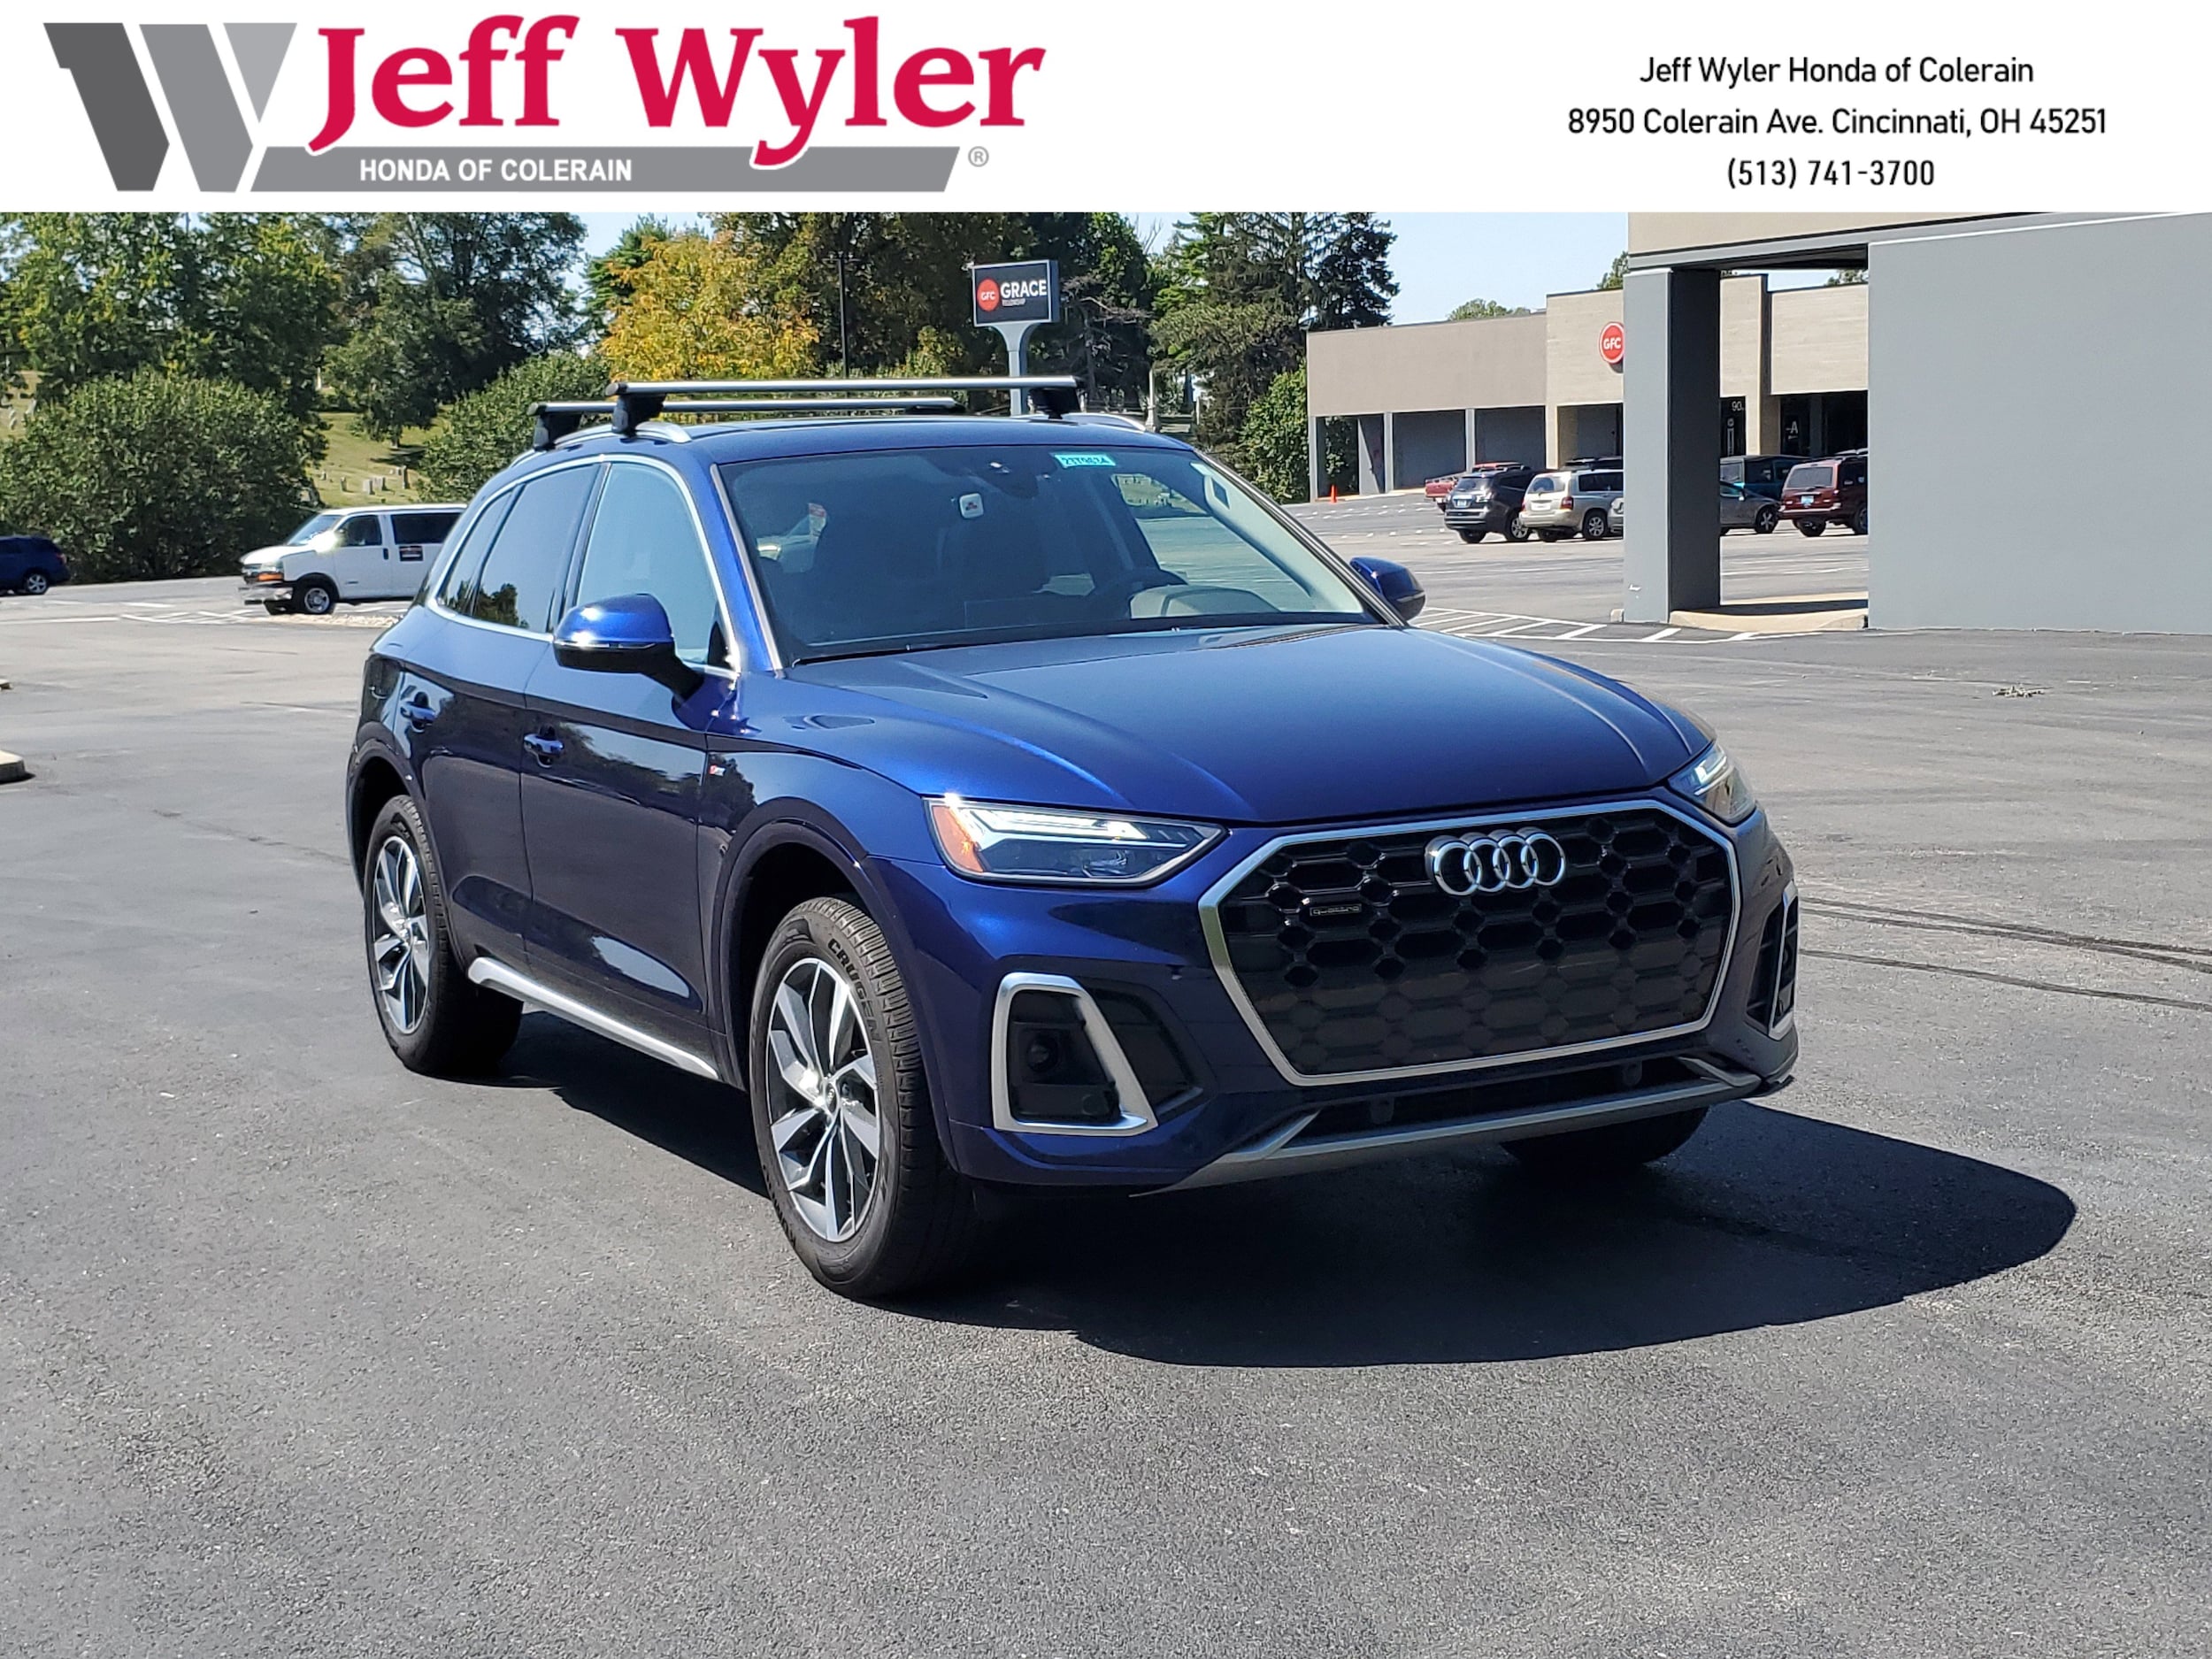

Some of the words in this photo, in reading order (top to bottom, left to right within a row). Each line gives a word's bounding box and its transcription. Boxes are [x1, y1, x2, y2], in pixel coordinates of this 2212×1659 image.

[980, 291, 996, 300] GFC
[1000, 280, 1048, 298] GRACE
[1602, 337, 1622, 350] GFC
